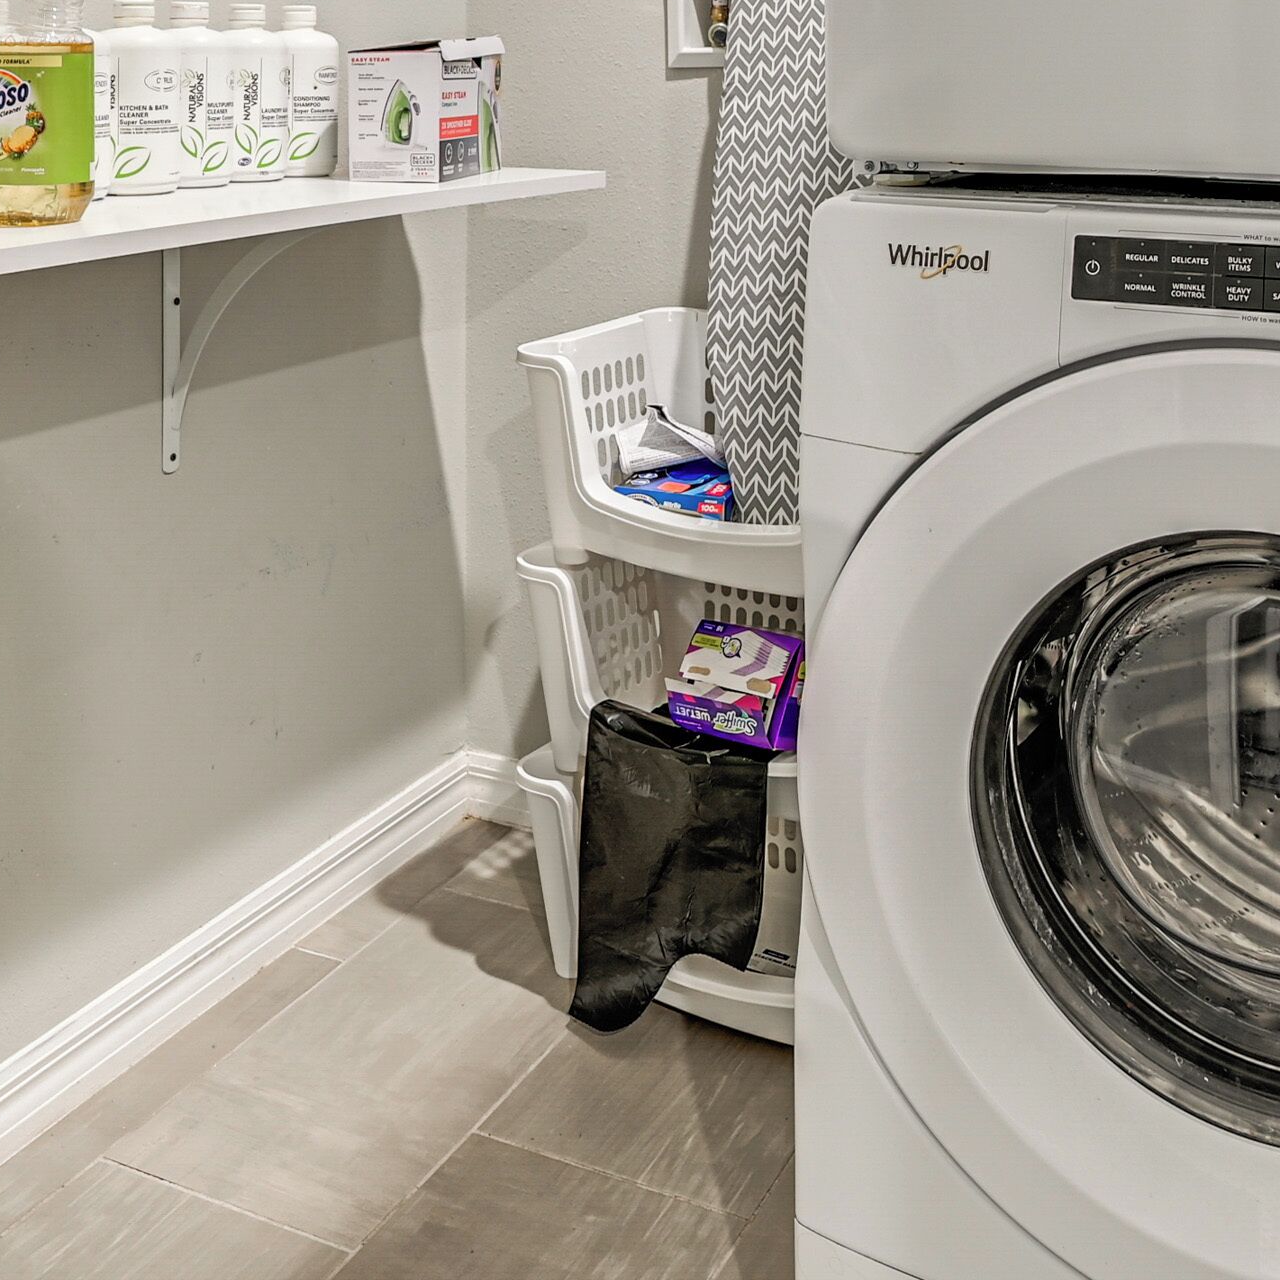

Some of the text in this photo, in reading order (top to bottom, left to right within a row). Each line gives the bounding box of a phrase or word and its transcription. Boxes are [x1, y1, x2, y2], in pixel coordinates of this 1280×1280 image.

[196, 73, 204, 108] VISIONS
[251, 73, 259, 107] VISIONS
[188, 83, 197, 123] NATURAL
[243, 84, 251, 121] NATURAL
[0, 106, 22, 118] Cleaner
[888, 243, 989, 275] Whirlpool
[1125, 253, 1209, 265] REGULAR DELICATES
[1227, 256, 1253, 265] BULKY
[1228, 264, 1251, 272] ITEMS
[1124, 283, 1157, 292] NORMAL
[1172, 282, 1206, 291] WRINKLE
[1226, 286, 1251, 295] HEAVY
[1170, 290, 1206, 299] CONTROL
[1228, 293, 1249, 302] DUTY
[675, 706, 758, 736] Swiffer WETJET
